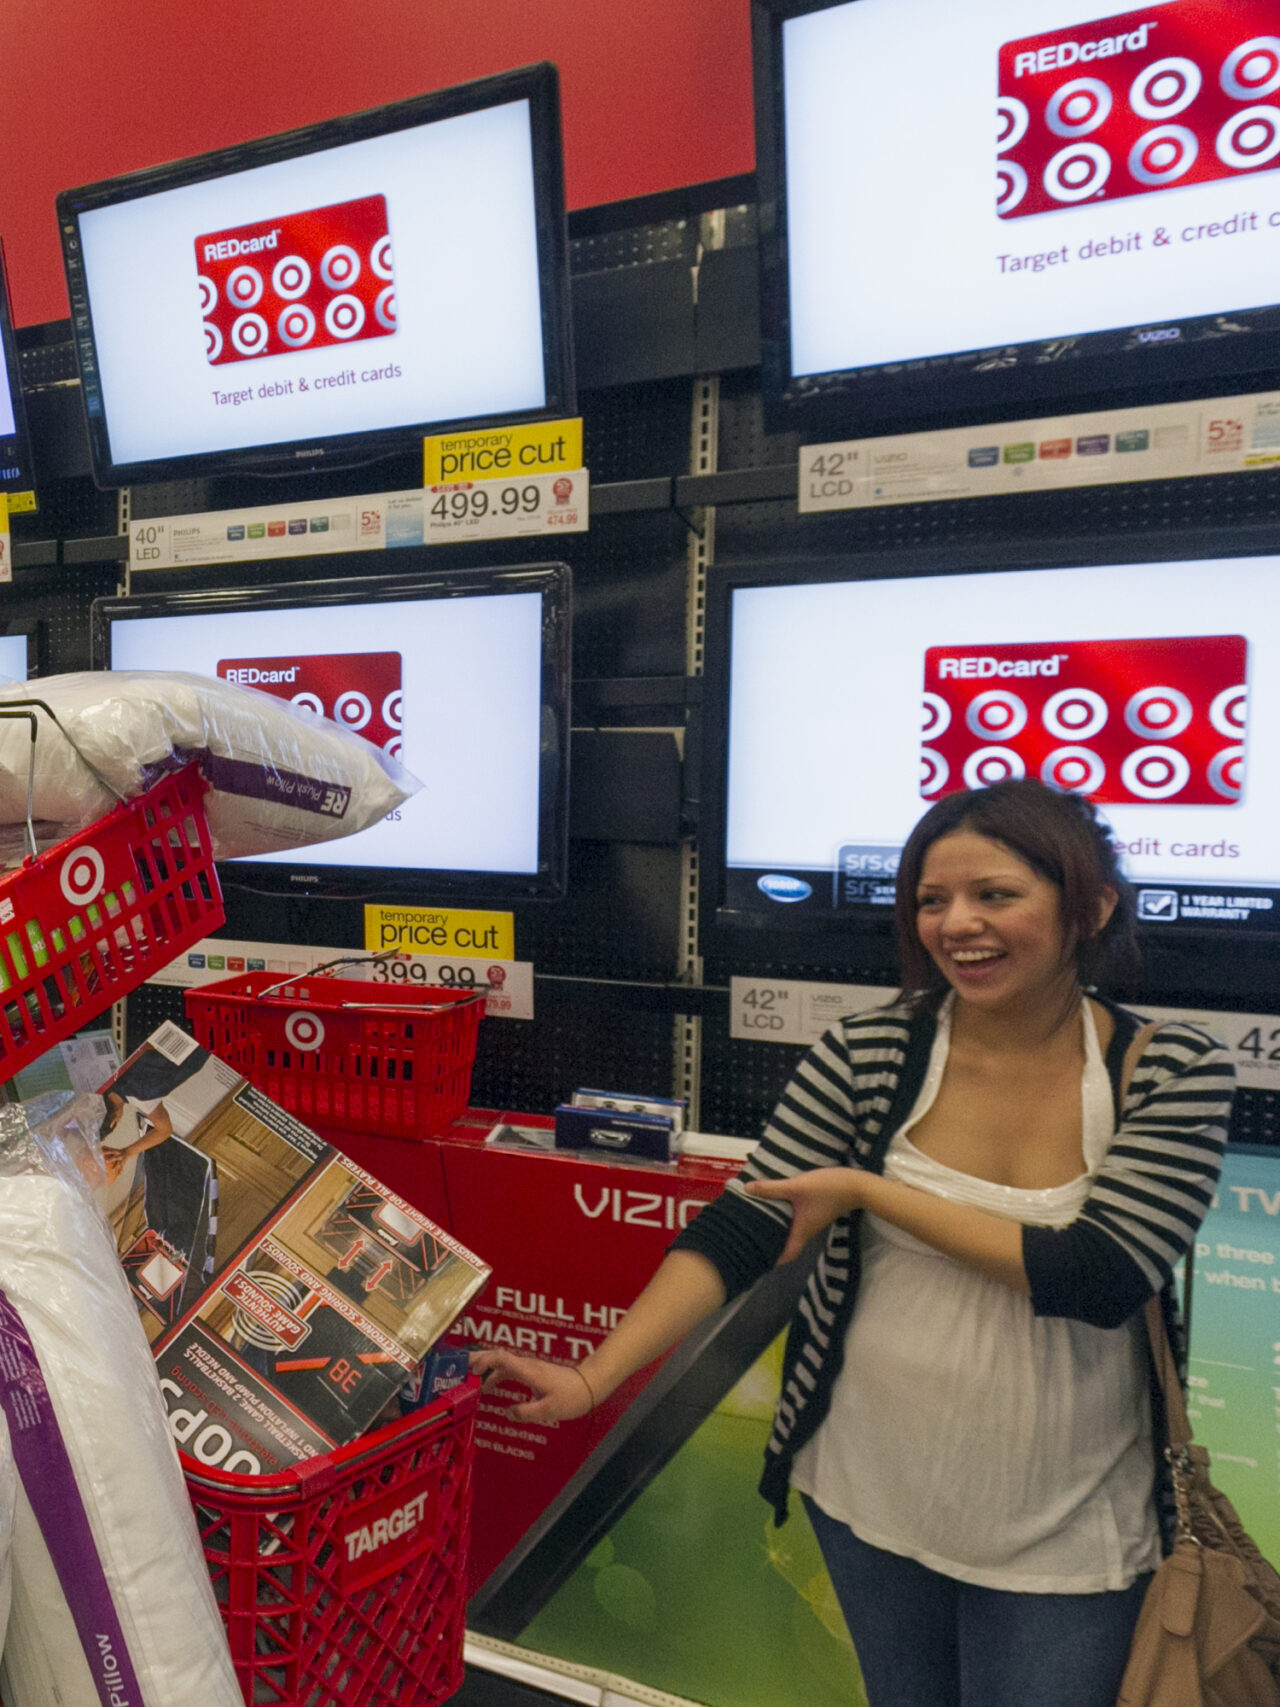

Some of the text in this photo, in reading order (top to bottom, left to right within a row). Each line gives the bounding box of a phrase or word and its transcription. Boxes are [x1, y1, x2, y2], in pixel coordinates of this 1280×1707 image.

[204, 231, 280, 263] REDcard
[997, 246, 1069, 275] Target
[1079, 231, 1141, 260] debit
[1153, 228, 1170, 246] &
[1181, 211, 1258, 243] credit
[213, 364, 402, 408] Target debit & credit cards
[440, 433, 513, 454] temporary
[440, 436, 567, 481] price cut
[809, 451, 859, 477] 42"
[431, 485, 541, 520] 499.99
[809, 480, 854, 500] LCD
[136, 546, 160, 560] LED
[939, 654, 1061, 681] REDcard
[320, 790, 349, 814] RE
[1112, 837, 1240, 858] edit cards
[1181, 907, 1251, 920] WARRANTY
[1192, 895, 1225, 907] YEAR
[380, 909, 448, 926] temporary
[380, 922, 499, 950] price cut
[372, 962, 476, 991] 39999
[742, 988, 789, 1011] 42"
[743, 1013, 785, 1031] LCD
[341, 1157, 487, 1269] ADJUSTABLE HEIGHT FOR ALL PLAYERS
[1229, 1185, 1280, 1216] TV
[1216, 1243, 1275, 1265] three
[1204, 1269, 1267, 1291] when
[233, 1277, 302, 1335] GAME SOUNDS!
[236, 1290, 287, 1333] AUTHENTIC
[261, 1239, 411, 1364] ELECTRONIC SCORING AND SOUNDS!
[496, 1286, 575, 1322] FULL
[190, 1342, 221, 1372] NEEDLE
[170, 1364, 207, 1402] scoring
[217, 1367, 239, 1388] AND
[328, 1358, 363, 1394] 38
[231, 1392, 240, 1401] 2
[235, 1382, 260, 1407] PUMP
[205, 1400, 230, 1424] LED
[256, 1402, 298, 1441] INFLATION
[300, 1440, 321, 1461] ND
[345, 1491, 429, 1562] TARGET
